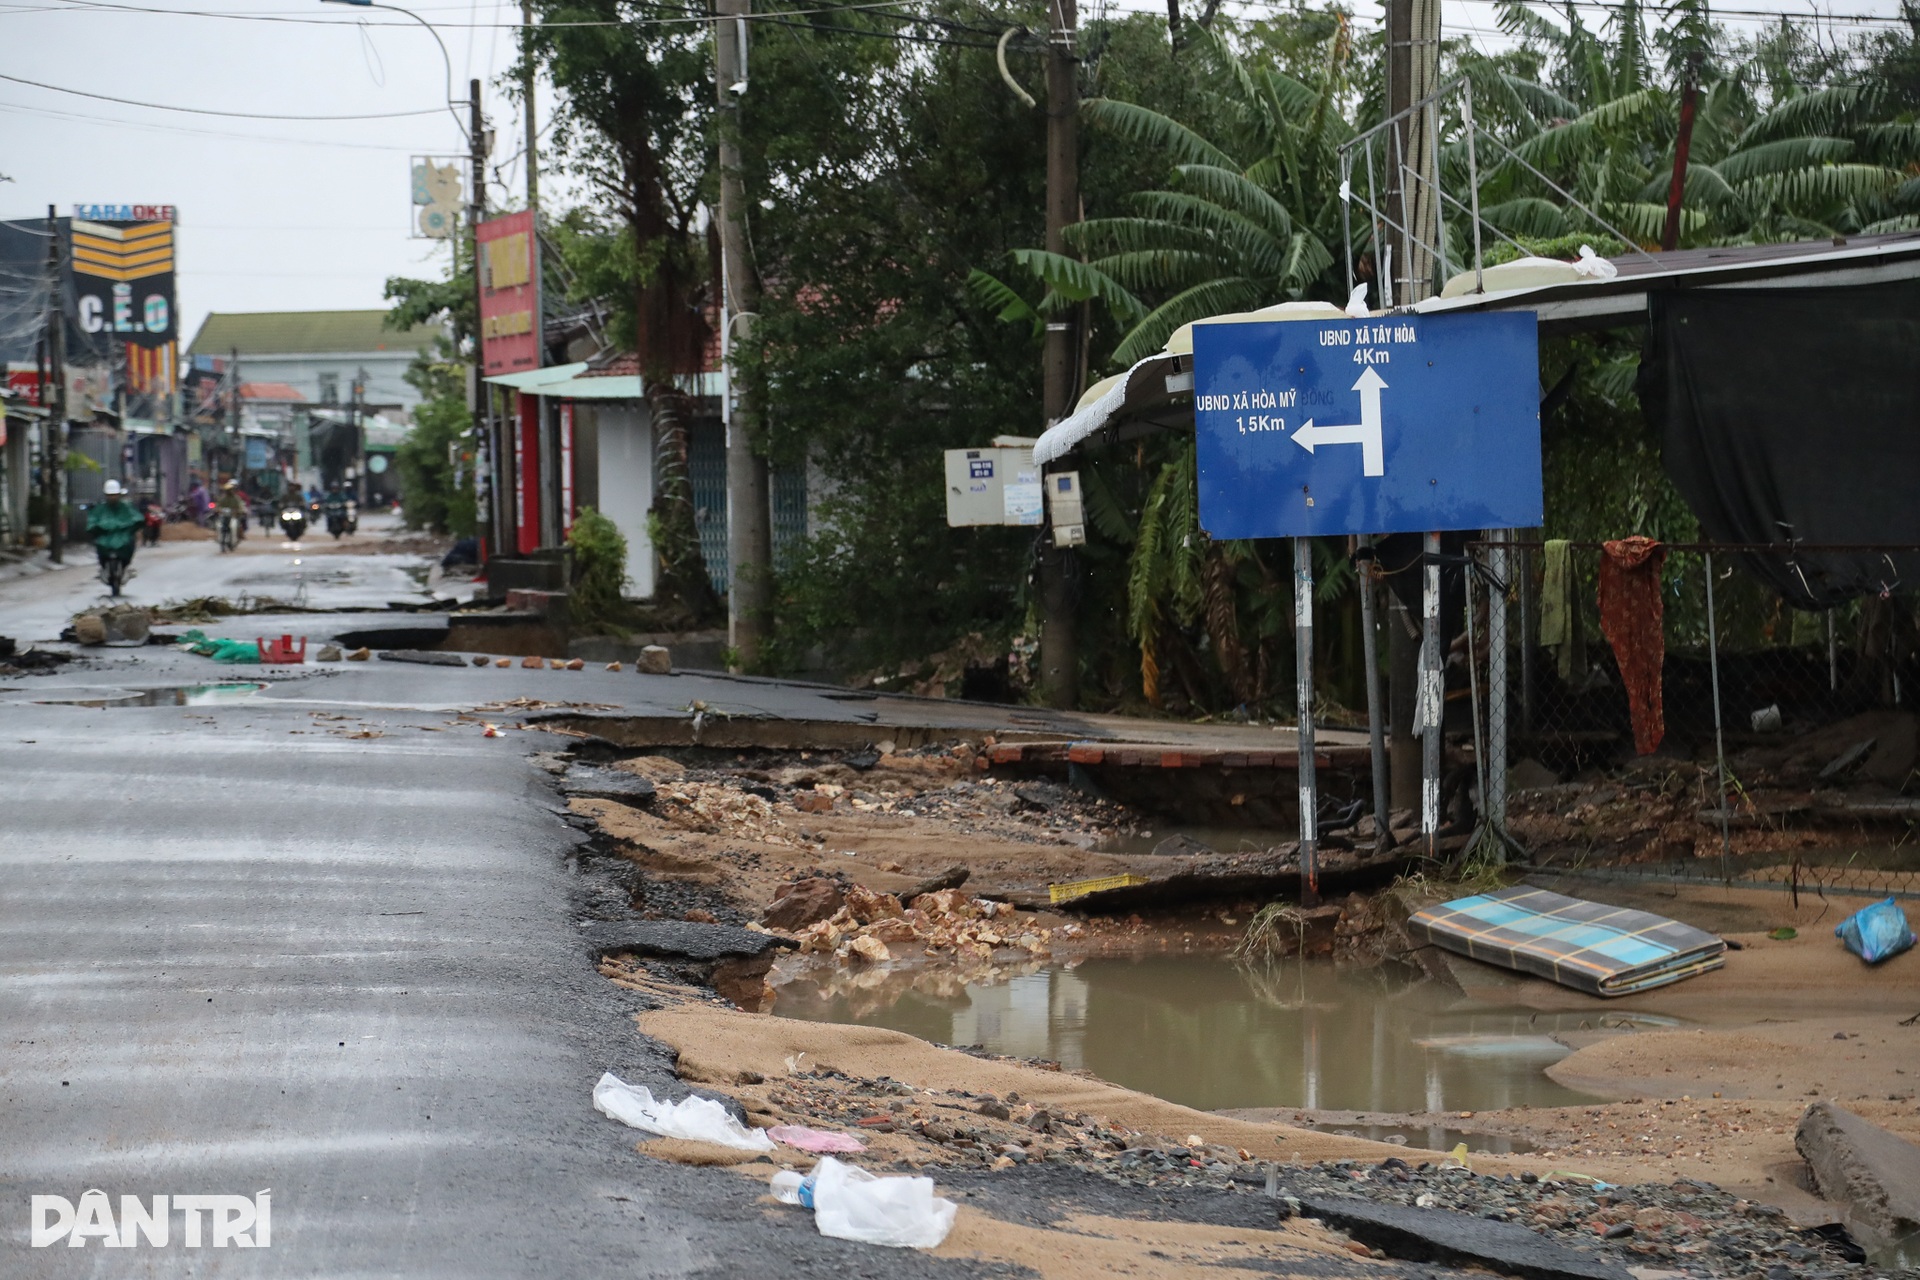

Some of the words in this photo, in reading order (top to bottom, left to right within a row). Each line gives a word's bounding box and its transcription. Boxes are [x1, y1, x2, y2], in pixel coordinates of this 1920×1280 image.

[75, 204, 173, 221] KARAOKE
[1320, 330, 1351, 346] UBND
[1355, 326, 1370, 345] XÃ
[1372, 325, 1391, 344] TÂY
[1394, 323, 1416, 343] HÒA
[1353, 348, 1390, 365] 4Km
[1196, 395, 1230, 412] UBND
[1233, 391, 1249, 410] XÃ
[1251, 389, 1277, 409] HÒA
[1279, 388, 1297, 408] MỸ
[1236, 415, 1285, 436] 1,5Km
